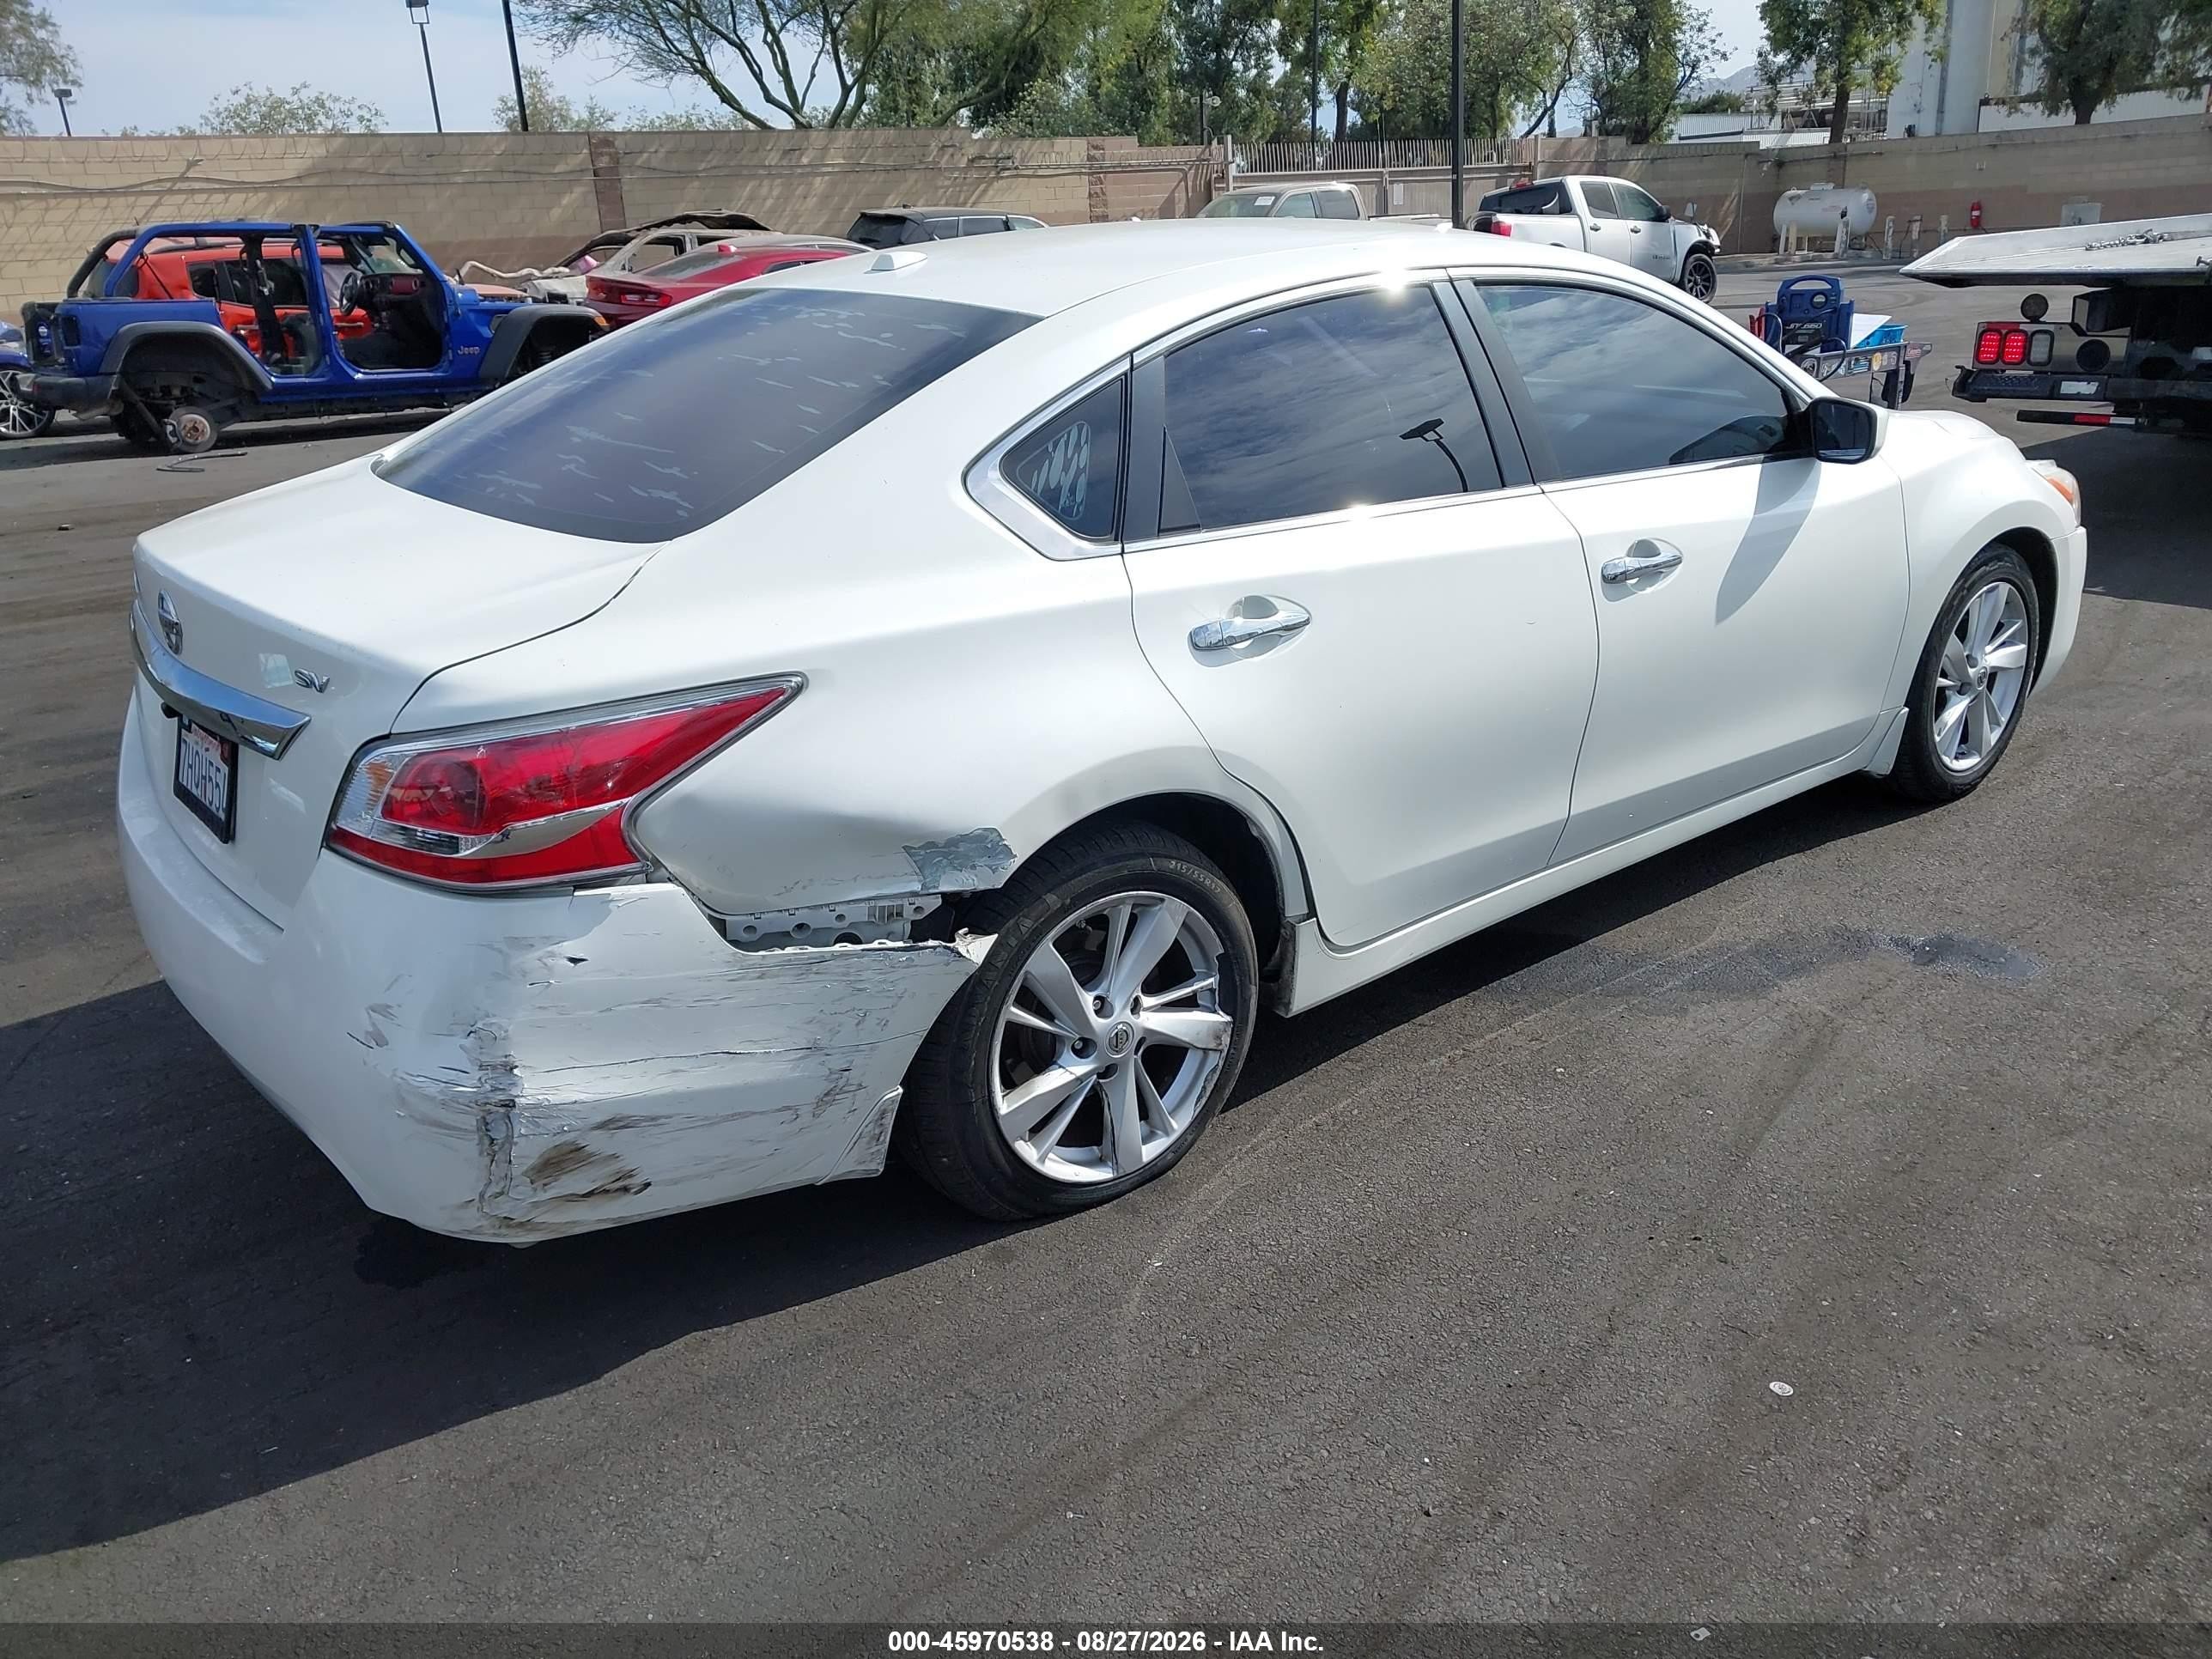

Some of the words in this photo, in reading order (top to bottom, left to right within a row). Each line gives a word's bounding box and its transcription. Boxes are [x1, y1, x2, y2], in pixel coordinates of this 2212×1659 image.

[457, 345, 481, 356] Jeep
[294, 667, 331, 694] SV
[1168, 860, 1221, 893] 215/55R17
